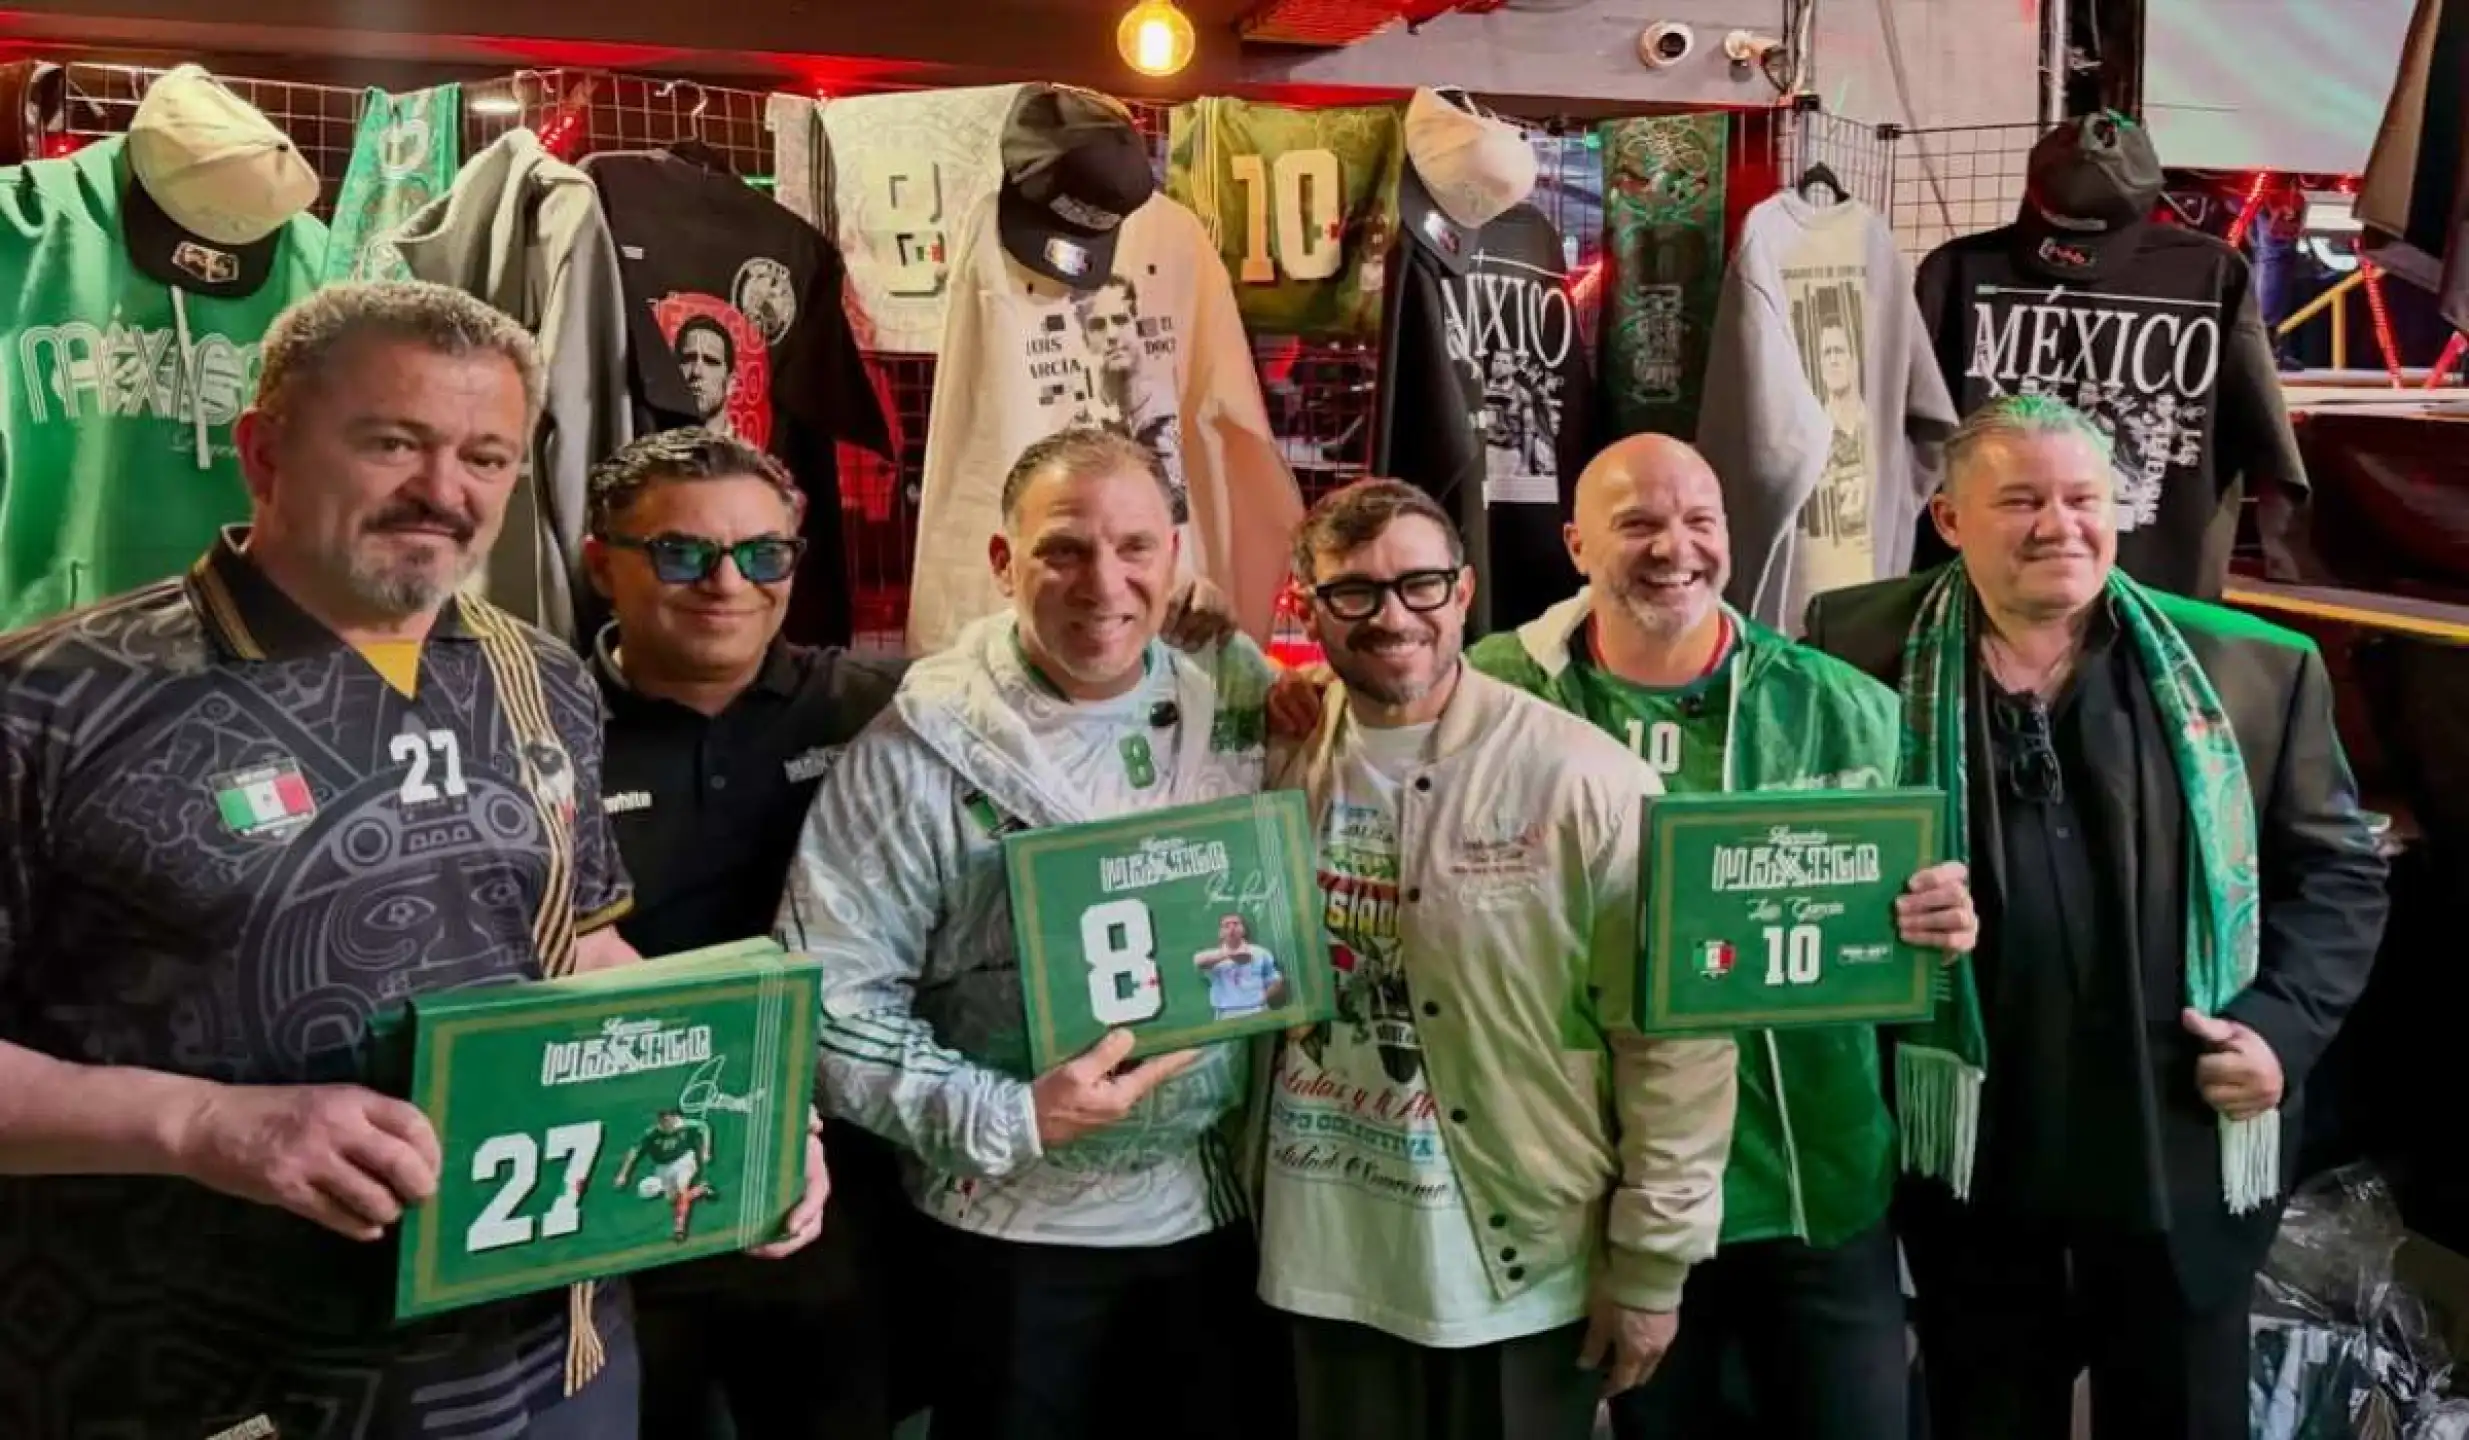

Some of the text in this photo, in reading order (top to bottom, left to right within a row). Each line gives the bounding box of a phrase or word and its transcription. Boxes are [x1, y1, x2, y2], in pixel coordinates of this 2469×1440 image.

[1231, 149, 1343, 281] 10
[1964, 285, 2221, 399] MÉXICO
[389, 729, 468, 803] 27
[1118, 733, 1155, 790] 8
[1625, 718, 1683, 774] 10
[1080, 898, 1162, 1026] 8
[1762, 923, 1822, 985] 10
[466, 1120, 602, 1252] 27
